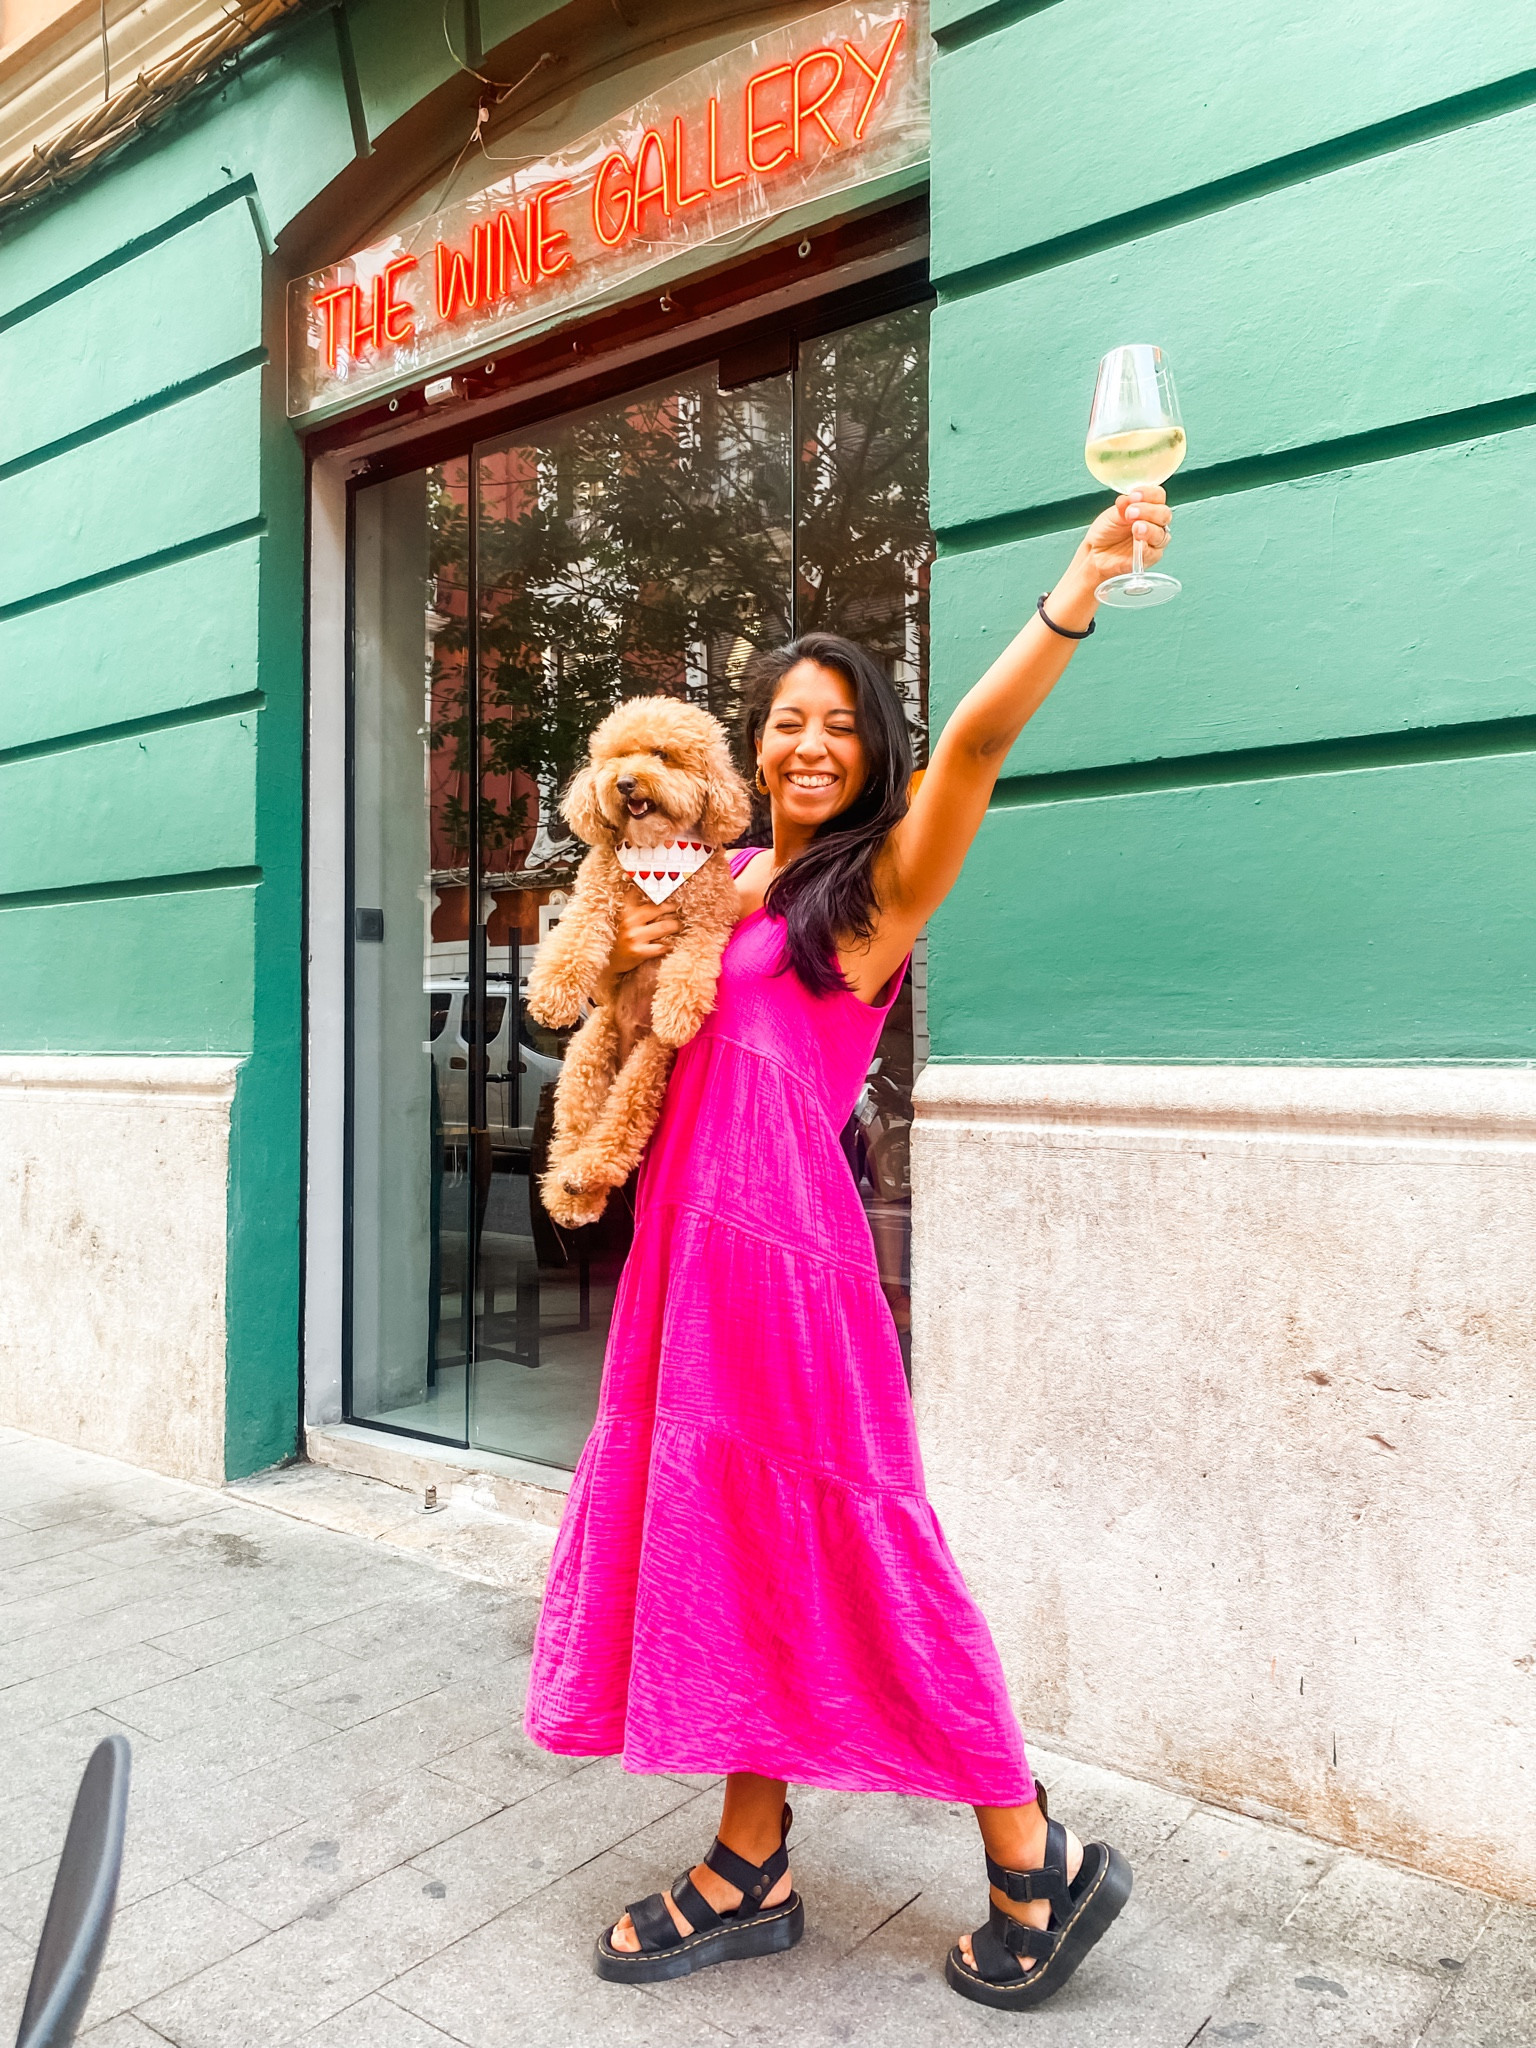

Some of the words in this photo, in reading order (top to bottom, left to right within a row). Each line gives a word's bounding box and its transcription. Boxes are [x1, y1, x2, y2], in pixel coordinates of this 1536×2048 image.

[314, 257, 416, 369] THE
[435, 180, 573, 319] WINE
[594, 19, 904, 245] GALLERY
